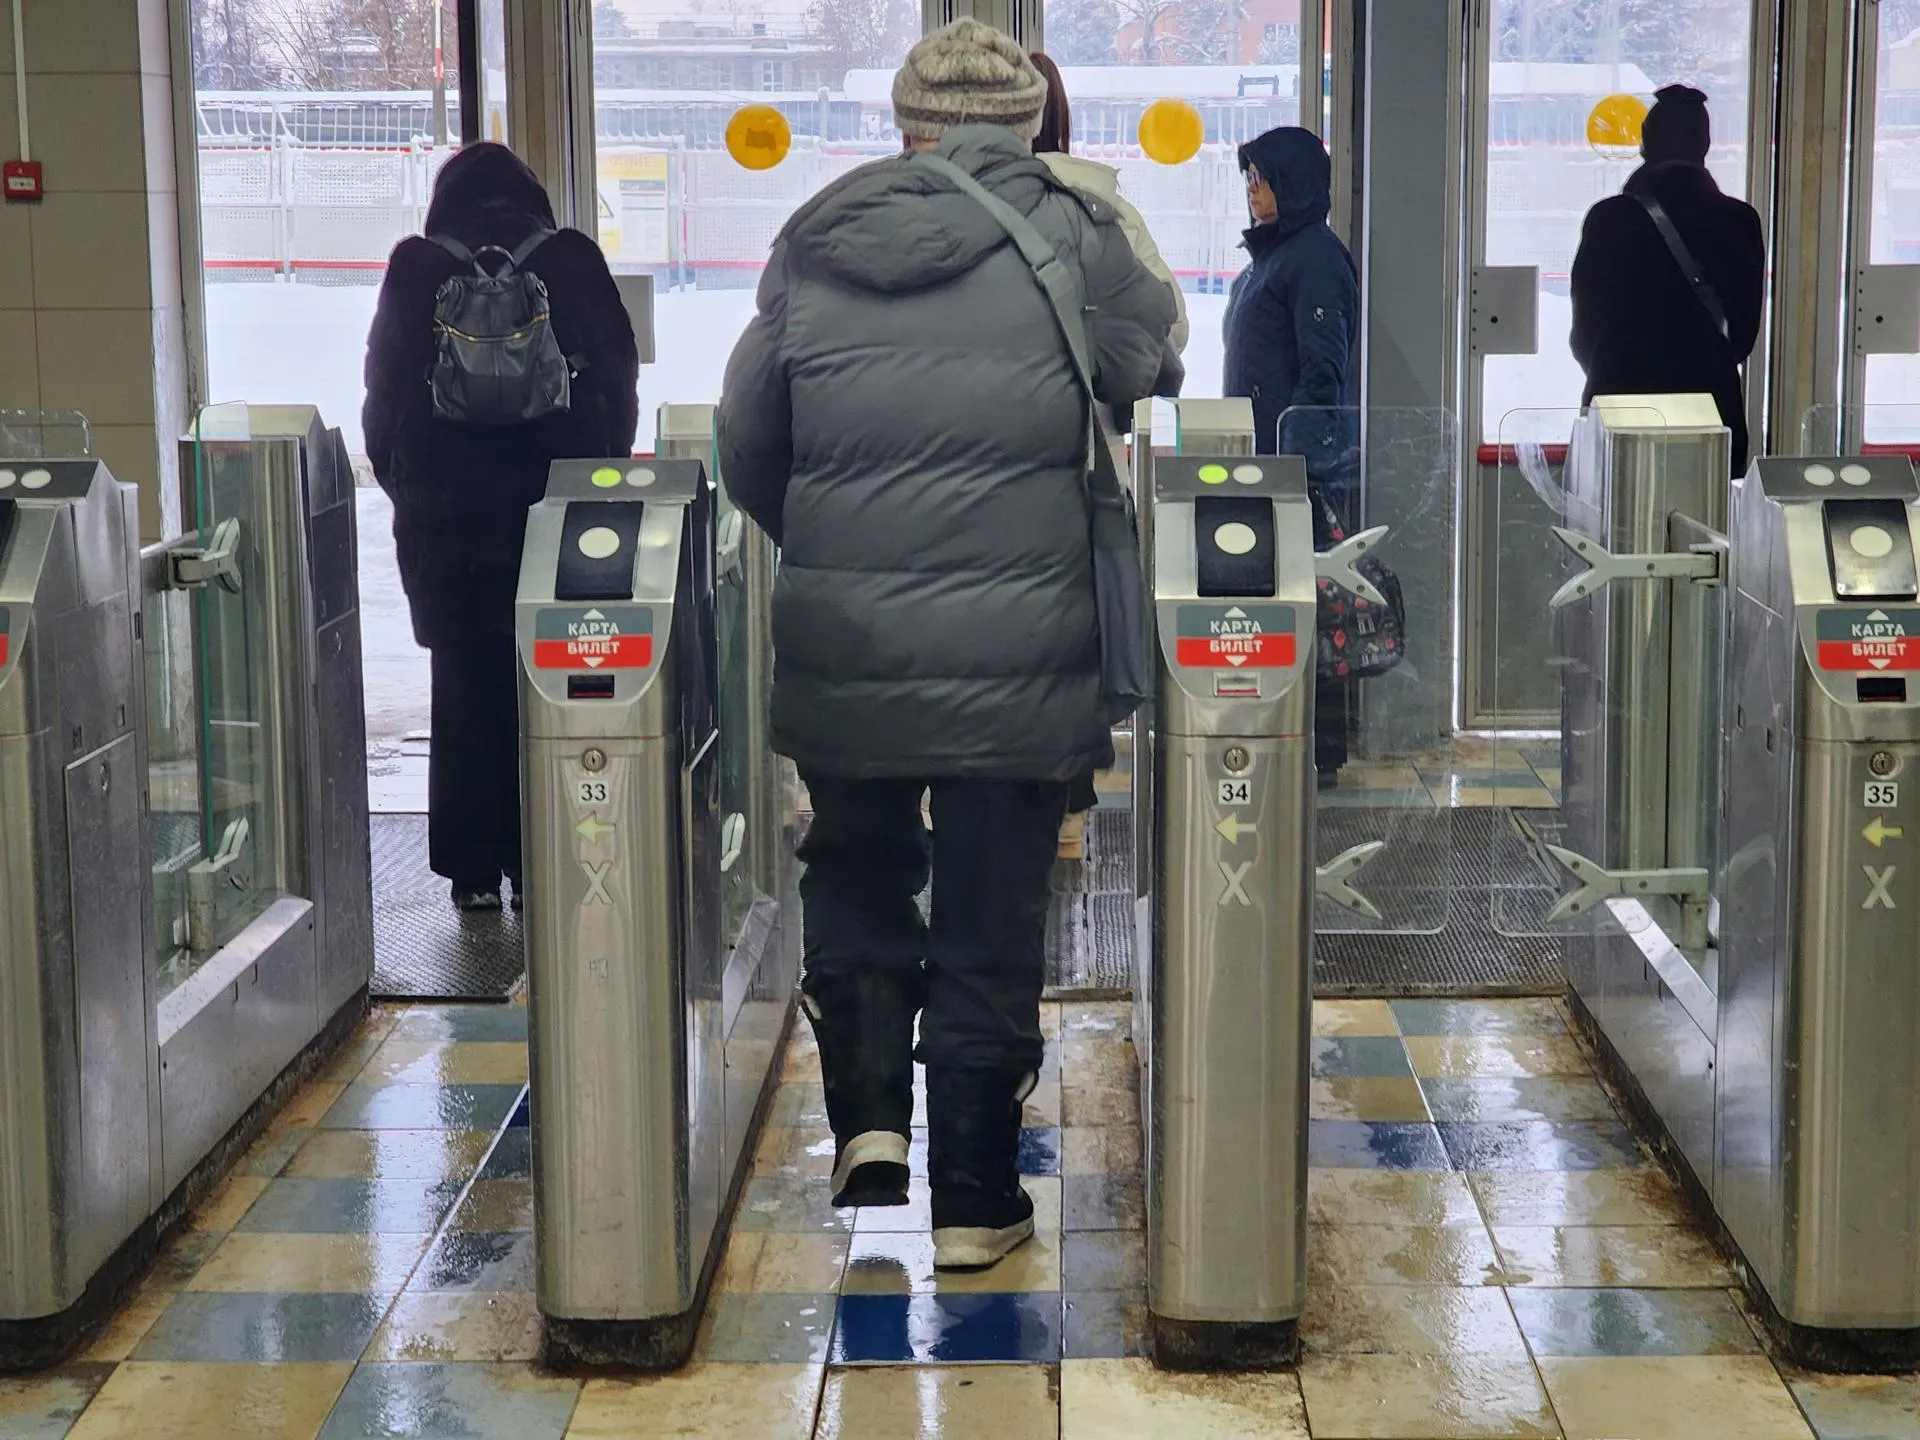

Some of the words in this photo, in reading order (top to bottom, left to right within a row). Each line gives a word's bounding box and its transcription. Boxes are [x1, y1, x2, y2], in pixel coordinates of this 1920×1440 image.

[568, 623, 620, 636] КАРТА
[1210, 620, 1263, 634] КАРТА
[1852, 623, 1906, 637] КАРТА
[567, 641, 621, 655] БИЛЕТ
[1210, 640, 1264, 653] БИЛЕТ
[1852, 643, 1907, 656] БИЛЕТ
[581, 783, 607, 802] 33
[1222, 783, 1249, 802] 34
[1867, 785, 1895, 804] 35
